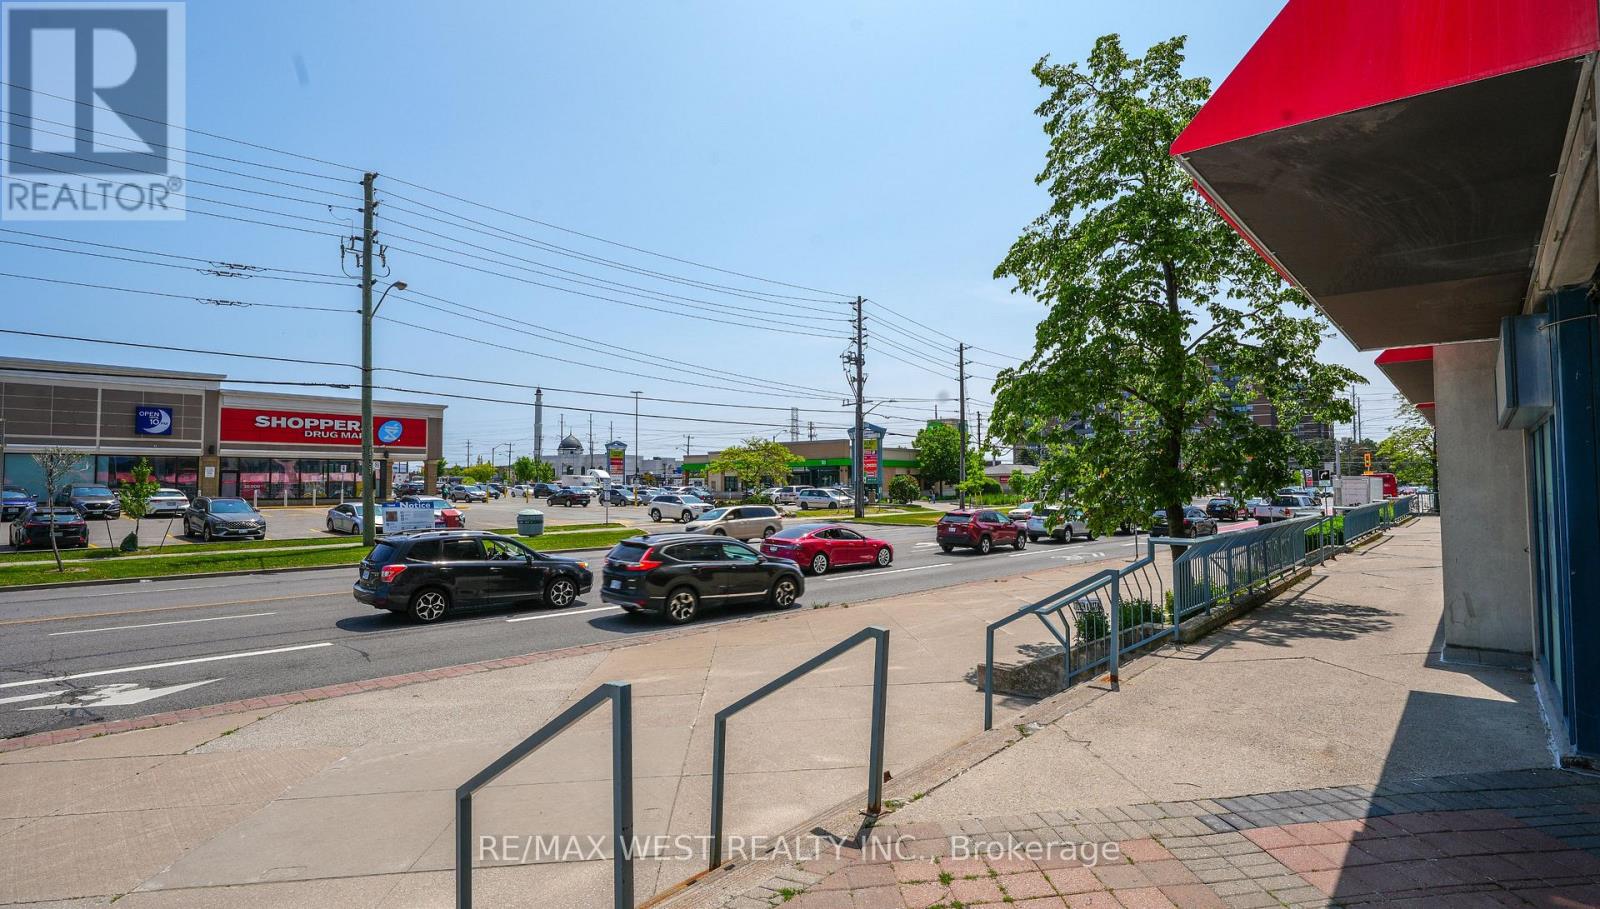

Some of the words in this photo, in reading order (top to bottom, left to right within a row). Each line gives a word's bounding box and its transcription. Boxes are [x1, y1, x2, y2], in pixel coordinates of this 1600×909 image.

[254, 415, 363, 432] SHOPPER
[304, 430, 339, 439] DRUG
[341, 431, 363, 440] MA
[400, 501, 431, 509] Notice
